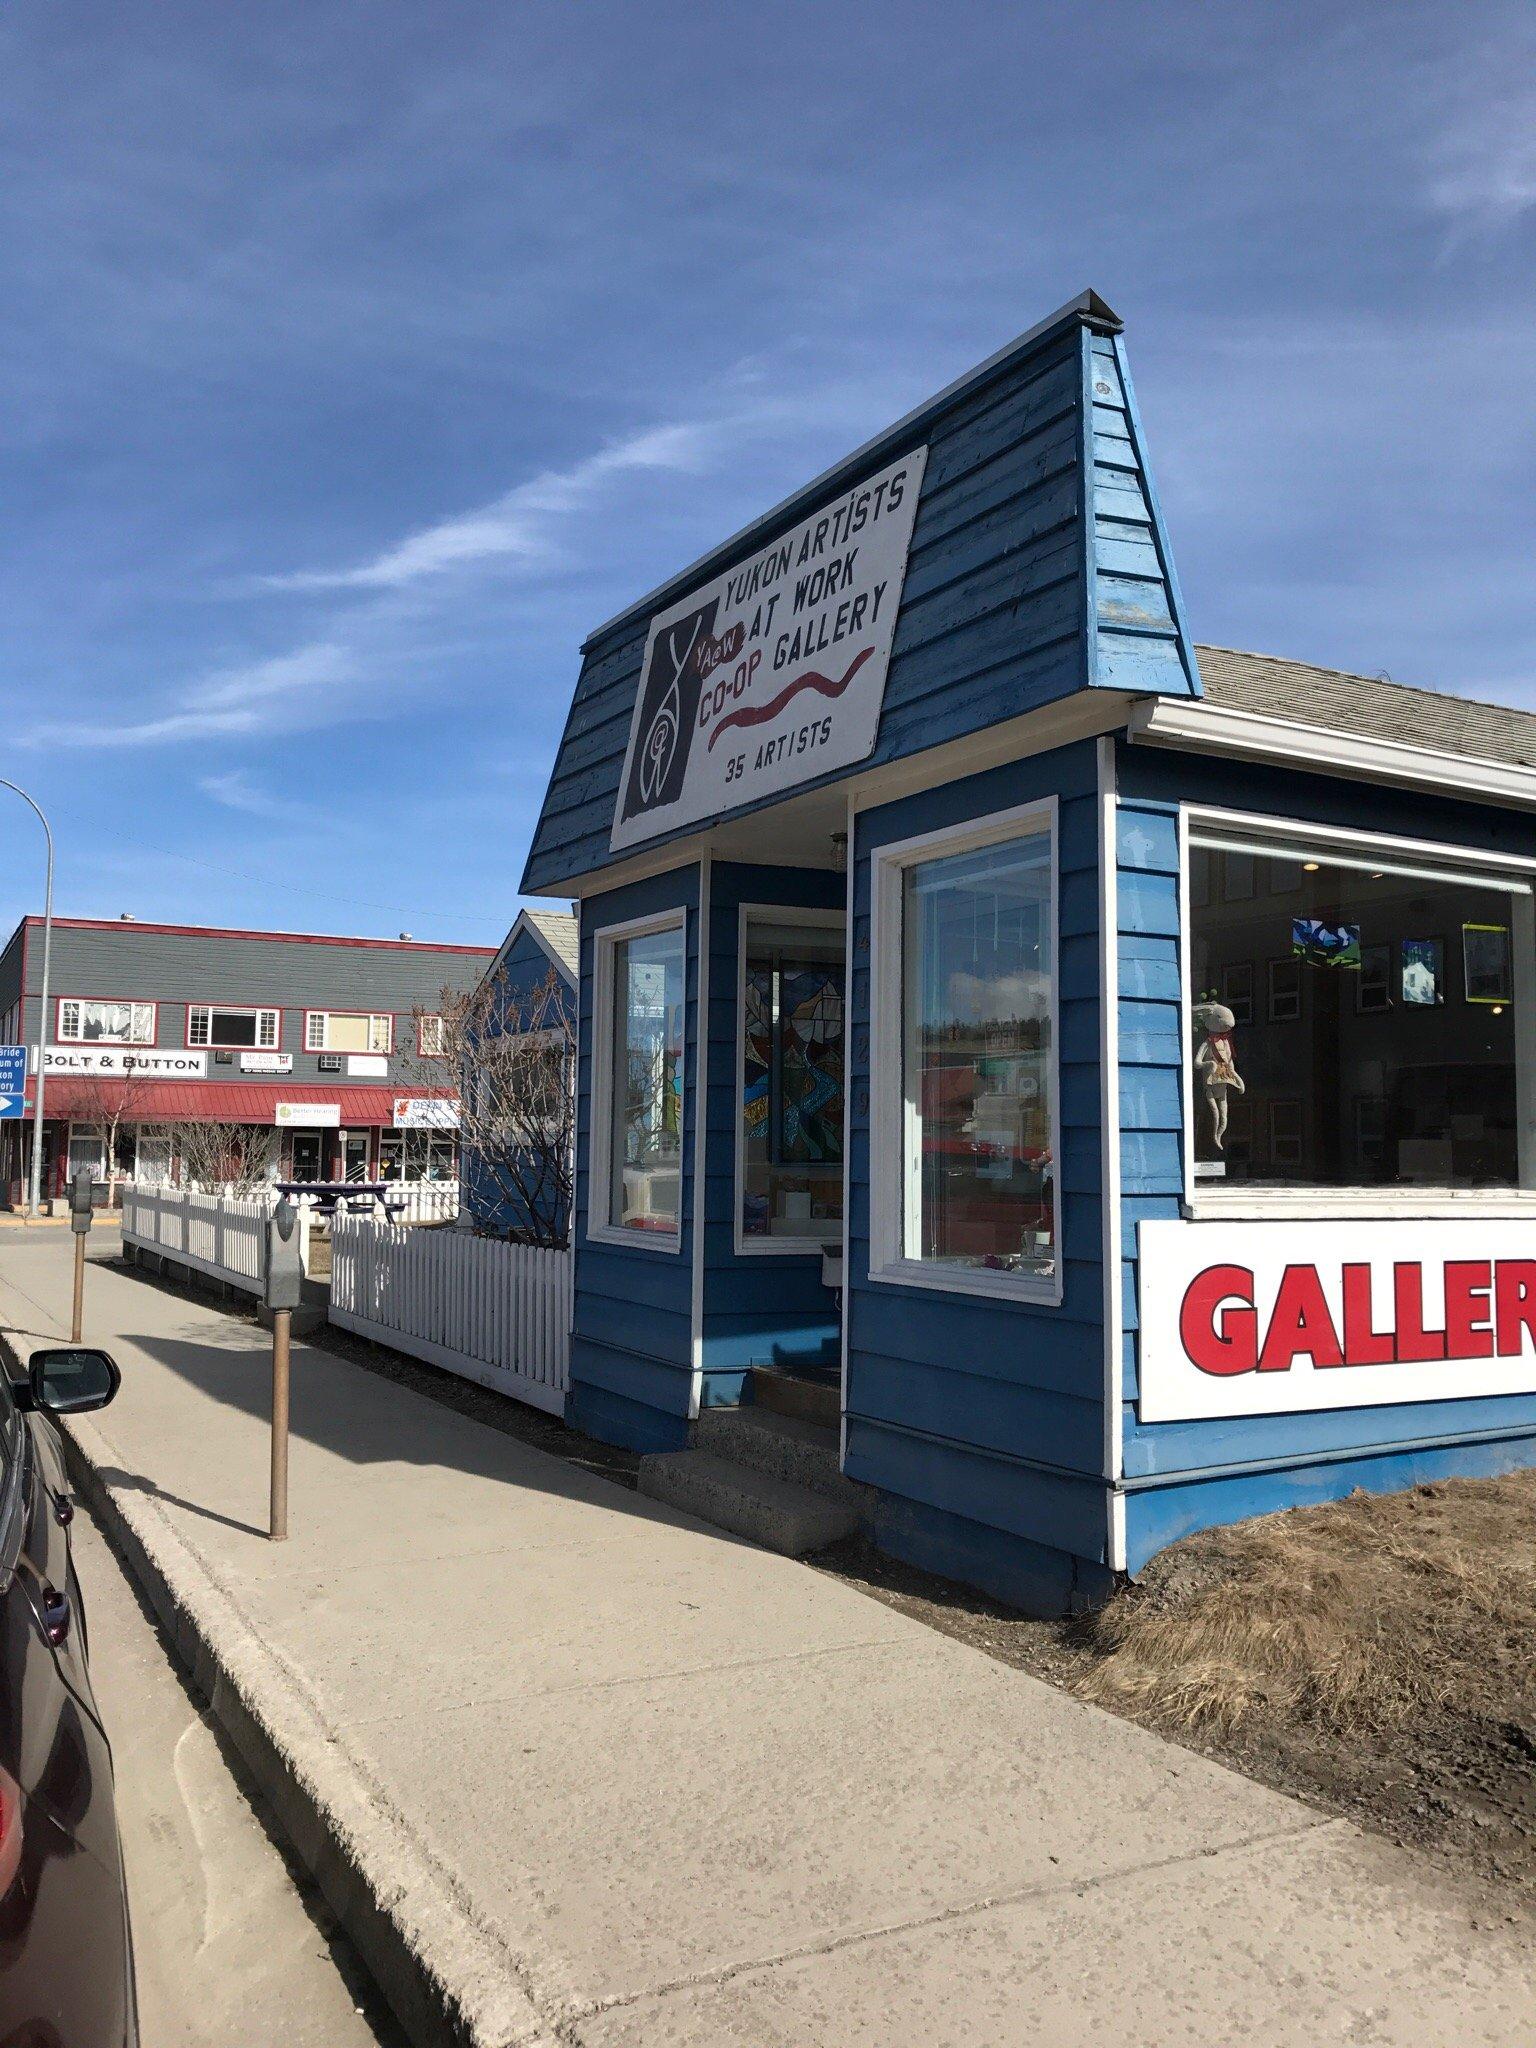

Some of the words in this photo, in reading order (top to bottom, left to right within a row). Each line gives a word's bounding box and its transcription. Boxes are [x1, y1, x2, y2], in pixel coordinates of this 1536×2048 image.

[723, 543, 793, 612] YUKON
[796, 469, 908, 568] ARTISTS
[749, 595, 780, 641] AT
[793, 548, 859, 614] WORK
[698, 649, 762, 728] CO-OP
[773, 581, 888, 672] GALLERY
[725, 753, 746, 783] 35
[754, 716, 832, 771] ARTISTS
[15, 1059, 24, 1068] of
[44, 1054, 93, 1067] BOLT
[99, 1056, 113, 1068] &
[122, 1056, 200, 1070] BUTTON
[1178, 1258, 1536, 1378] GALLER
